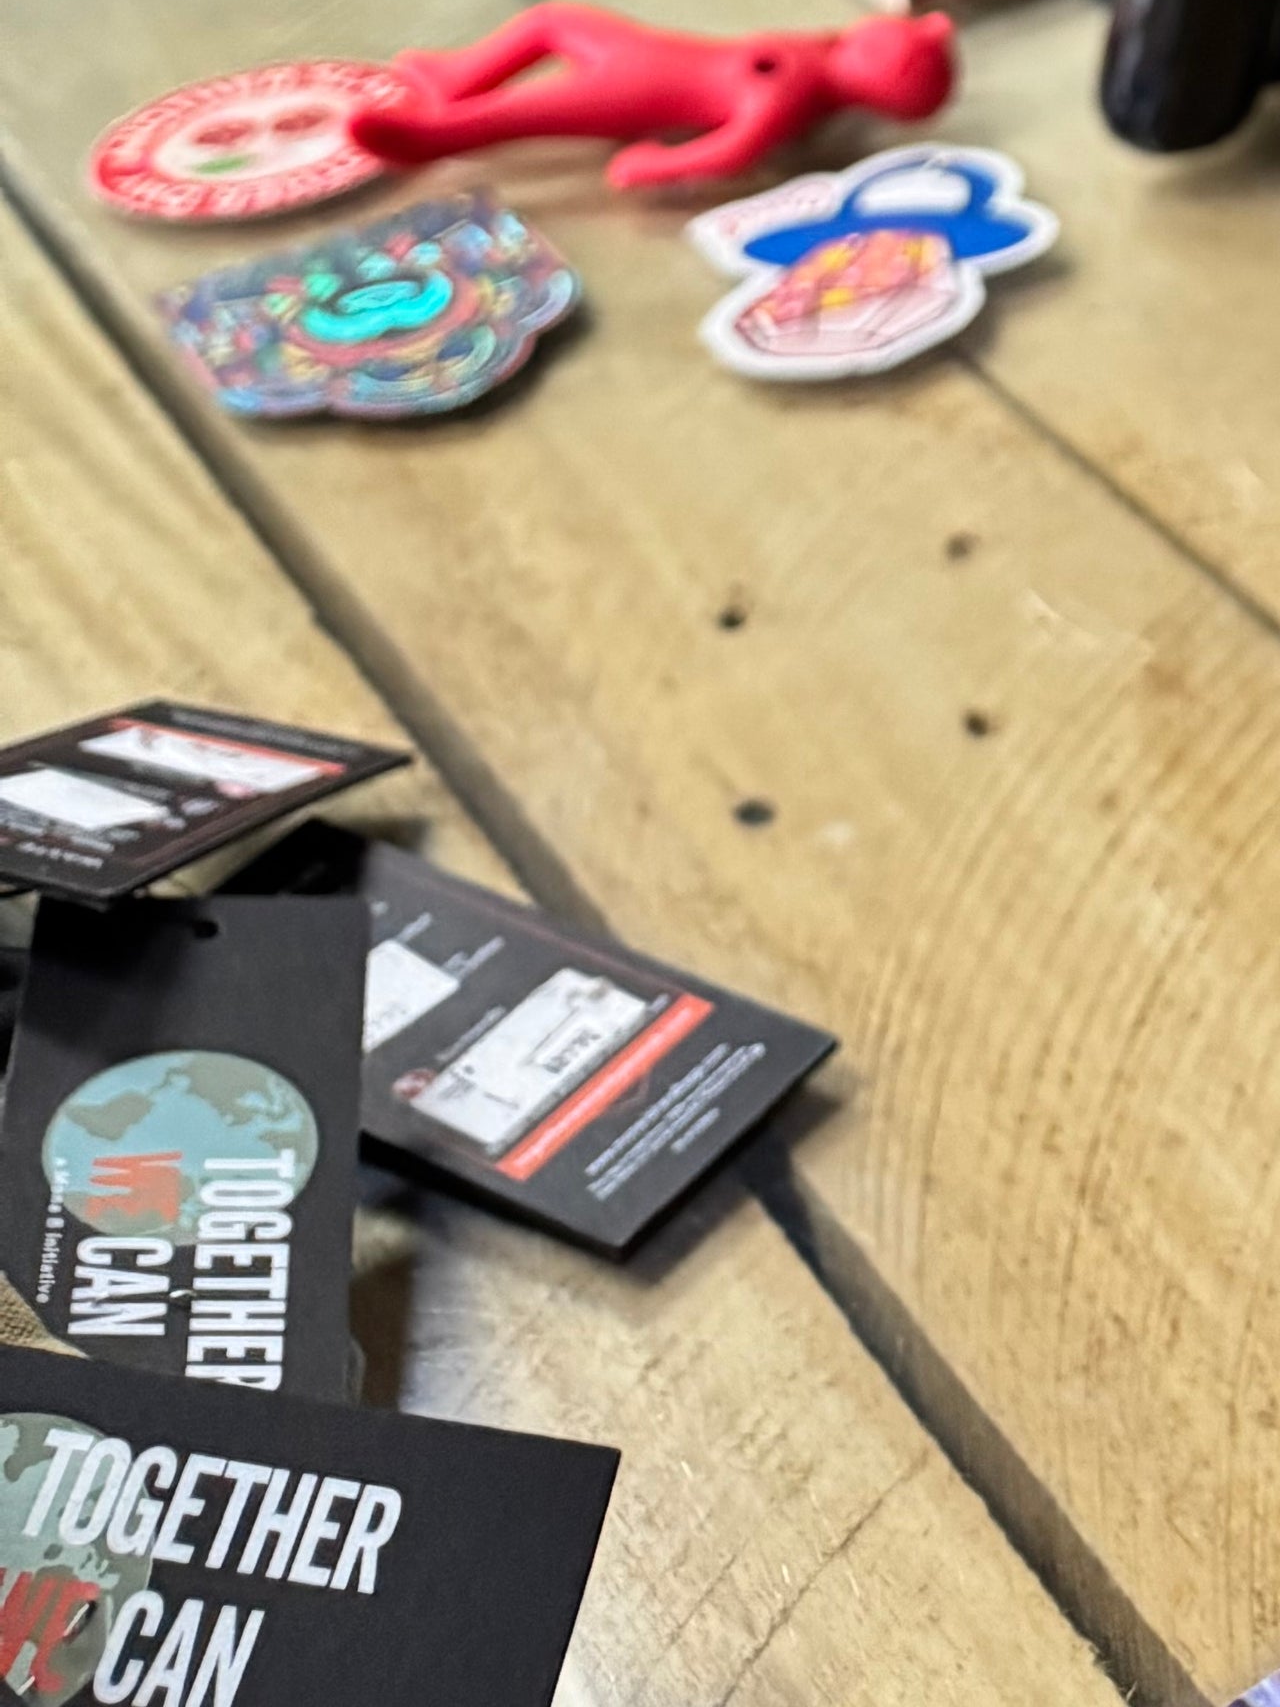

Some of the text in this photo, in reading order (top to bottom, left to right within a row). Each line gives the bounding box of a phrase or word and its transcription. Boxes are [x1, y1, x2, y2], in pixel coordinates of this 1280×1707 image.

[36, 1232, 64, 1304] Initiative
[67, 1236, 174, 1336] CAN
[185, 1148, 296, 1391] TOGETHER
[21, 1428, 402, 1595] TOGETHER
[93, 1589, 265, 1707] CAN
